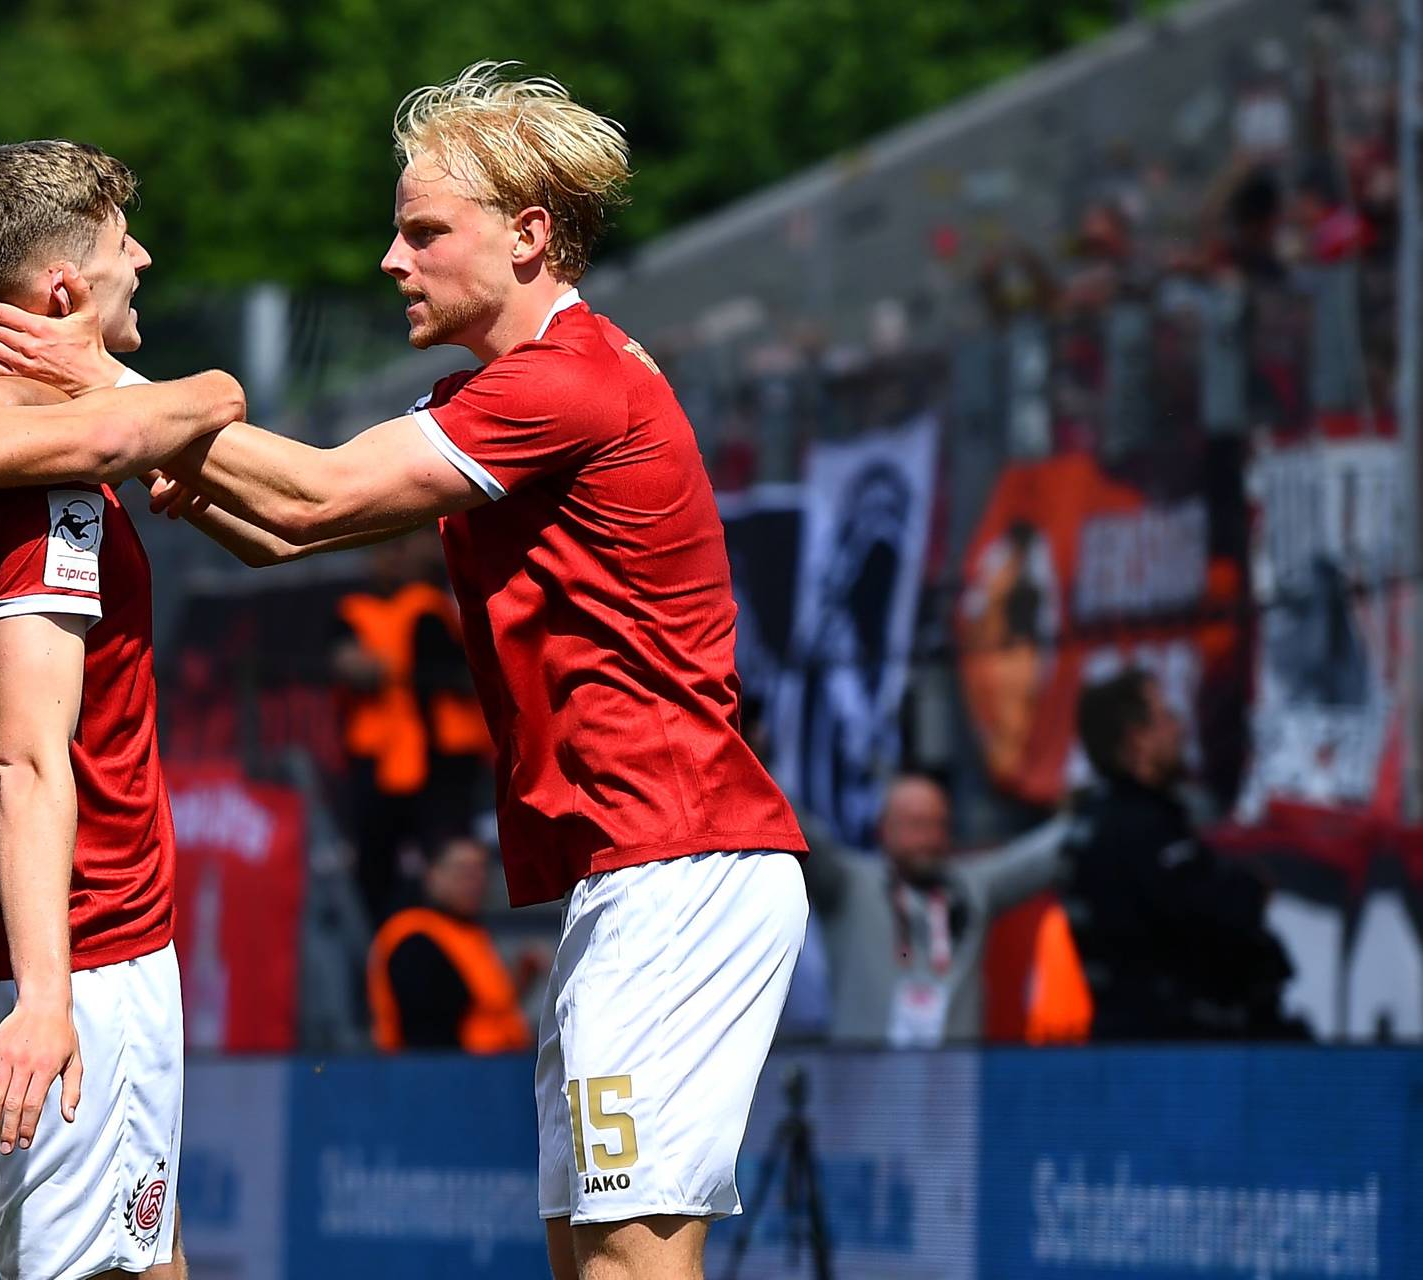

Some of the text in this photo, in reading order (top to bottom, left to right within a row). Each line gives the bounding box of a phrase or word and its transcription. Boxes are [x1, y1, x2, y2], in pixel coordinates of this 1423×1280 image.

[56, 563, 97, 581] tipico
[566, 1074, 639, 1173] 15
[584, 1174, 631, 1194] JAKO
